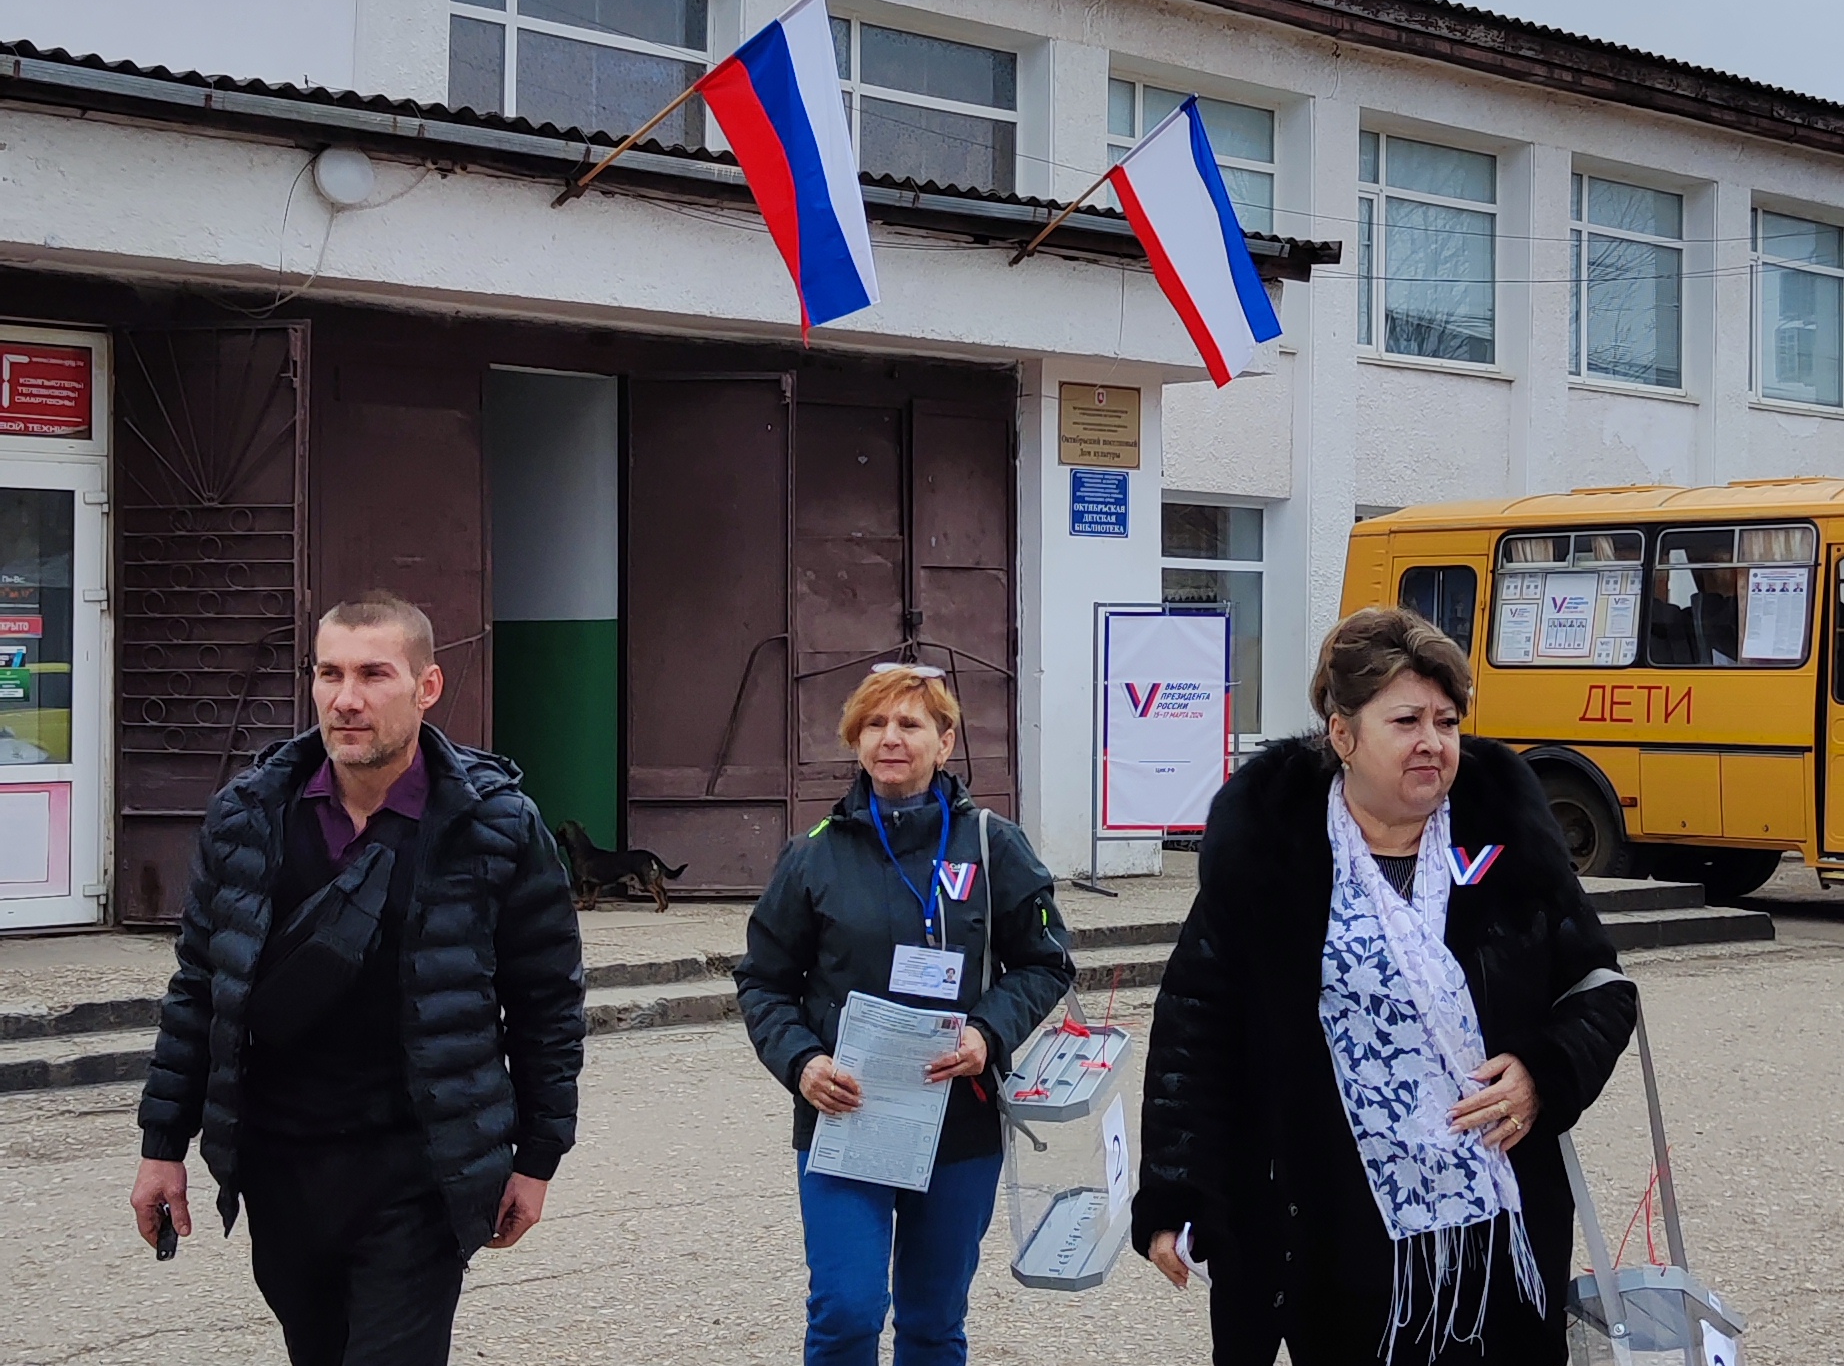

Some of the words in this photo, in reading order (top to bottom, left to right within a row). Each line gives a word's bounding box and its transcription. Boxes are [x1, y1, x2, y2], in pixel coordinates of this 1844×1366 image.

[1073, 502, 1126, 513] ОКТЯБРЬСКАЯ
[1082, 513, 1116, 523] ДЕТСКАЯ
[1074, 523, 1125, 533] БИБЛИОТЕКА
[1164, 682, 1201, 691] ВЫБОРЫ
[1160, 692, 1211, 701] ПРЕЗИДЕНТА
[1156, 702, 1189, 710] РОССИИ
[1578, 684, 1692, 725] ДЕТИ
[1112, 1134, 1123, 1186] 2
